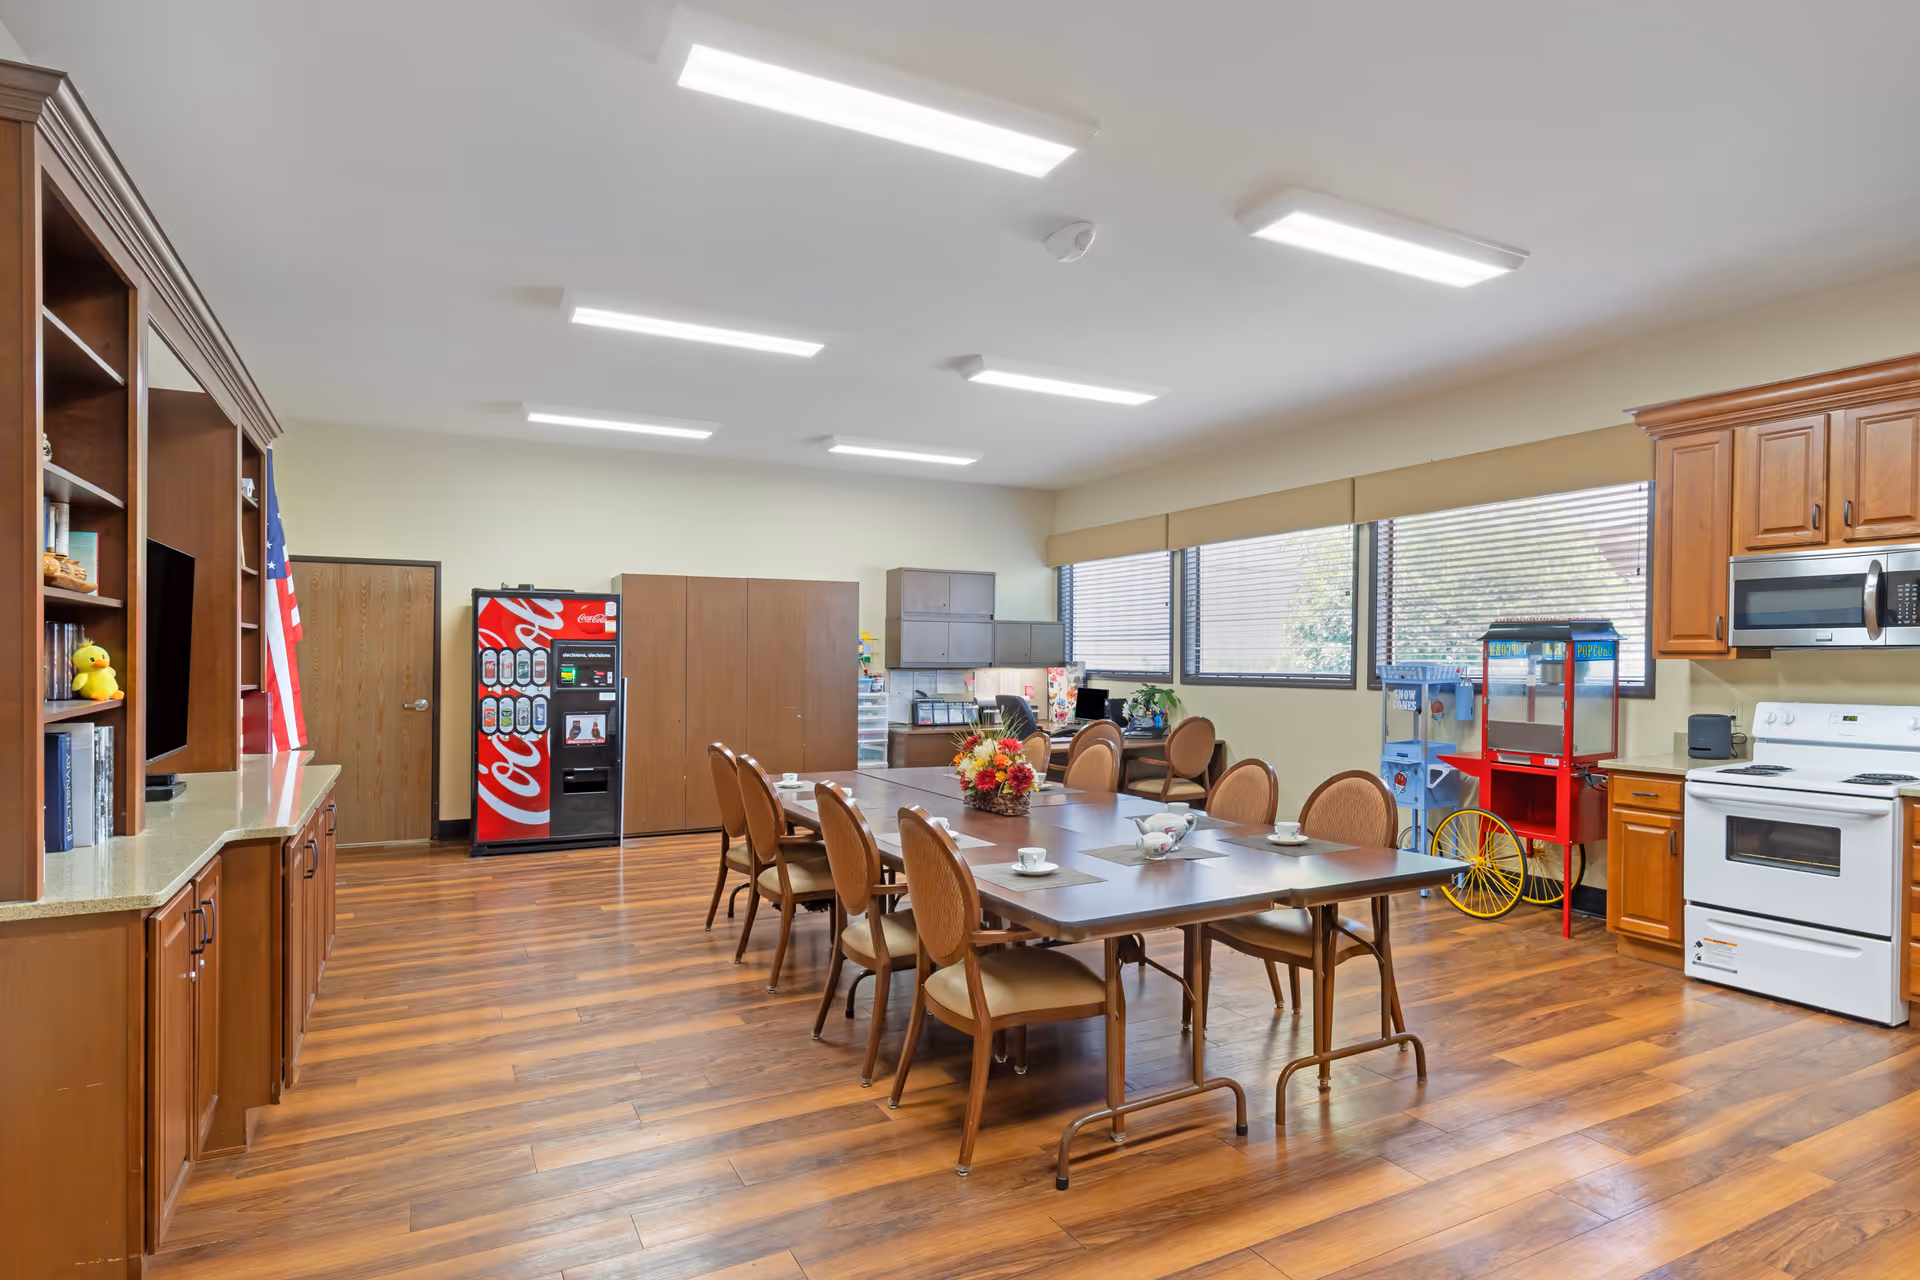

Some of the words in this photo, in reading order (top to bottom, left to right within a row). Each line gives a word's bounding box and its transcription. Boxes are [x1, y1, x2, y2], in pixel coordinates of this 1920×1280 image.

[577, 613, 607, 624] Coca-Cola
[1577, 643, 1614, 658] POPCORN
[1393, 688, 1416, 700] SNOW
[1392, 700, 1417, 711] CONES
[65, 753, 73, 832] DICTIONARY
